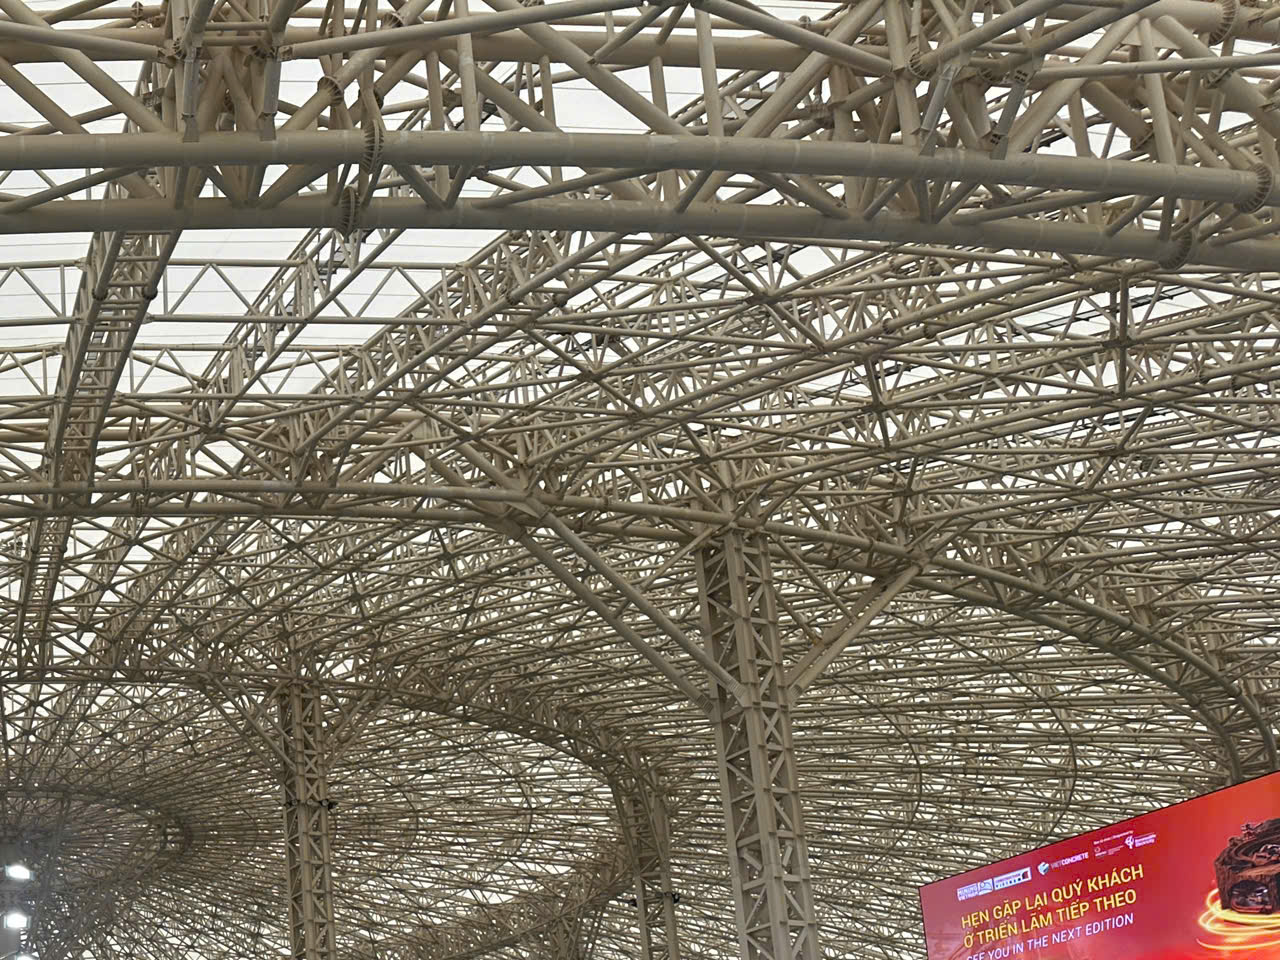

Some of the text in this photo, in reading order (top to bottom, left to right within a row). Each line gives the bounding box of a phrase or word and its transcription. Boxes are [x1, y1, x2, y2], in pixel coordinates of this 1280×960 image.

[961, 864, 1144, 931] HẸN GẶP LẠI QUÝ KHÁCH
[963, 931, 975, 948] Ở
[1021, 910, 1054, 933] LÃM
[1056, 901, 1090, 923] TIẾP
[1094, 887, 1138, 914] THEO
[1013, 941, 1024, 956] IN
[1027, 935, 1049, 952] THE
[1051, 927, 1082, 946] NEXT
[1085, 912, 1135, 937] EDITION
